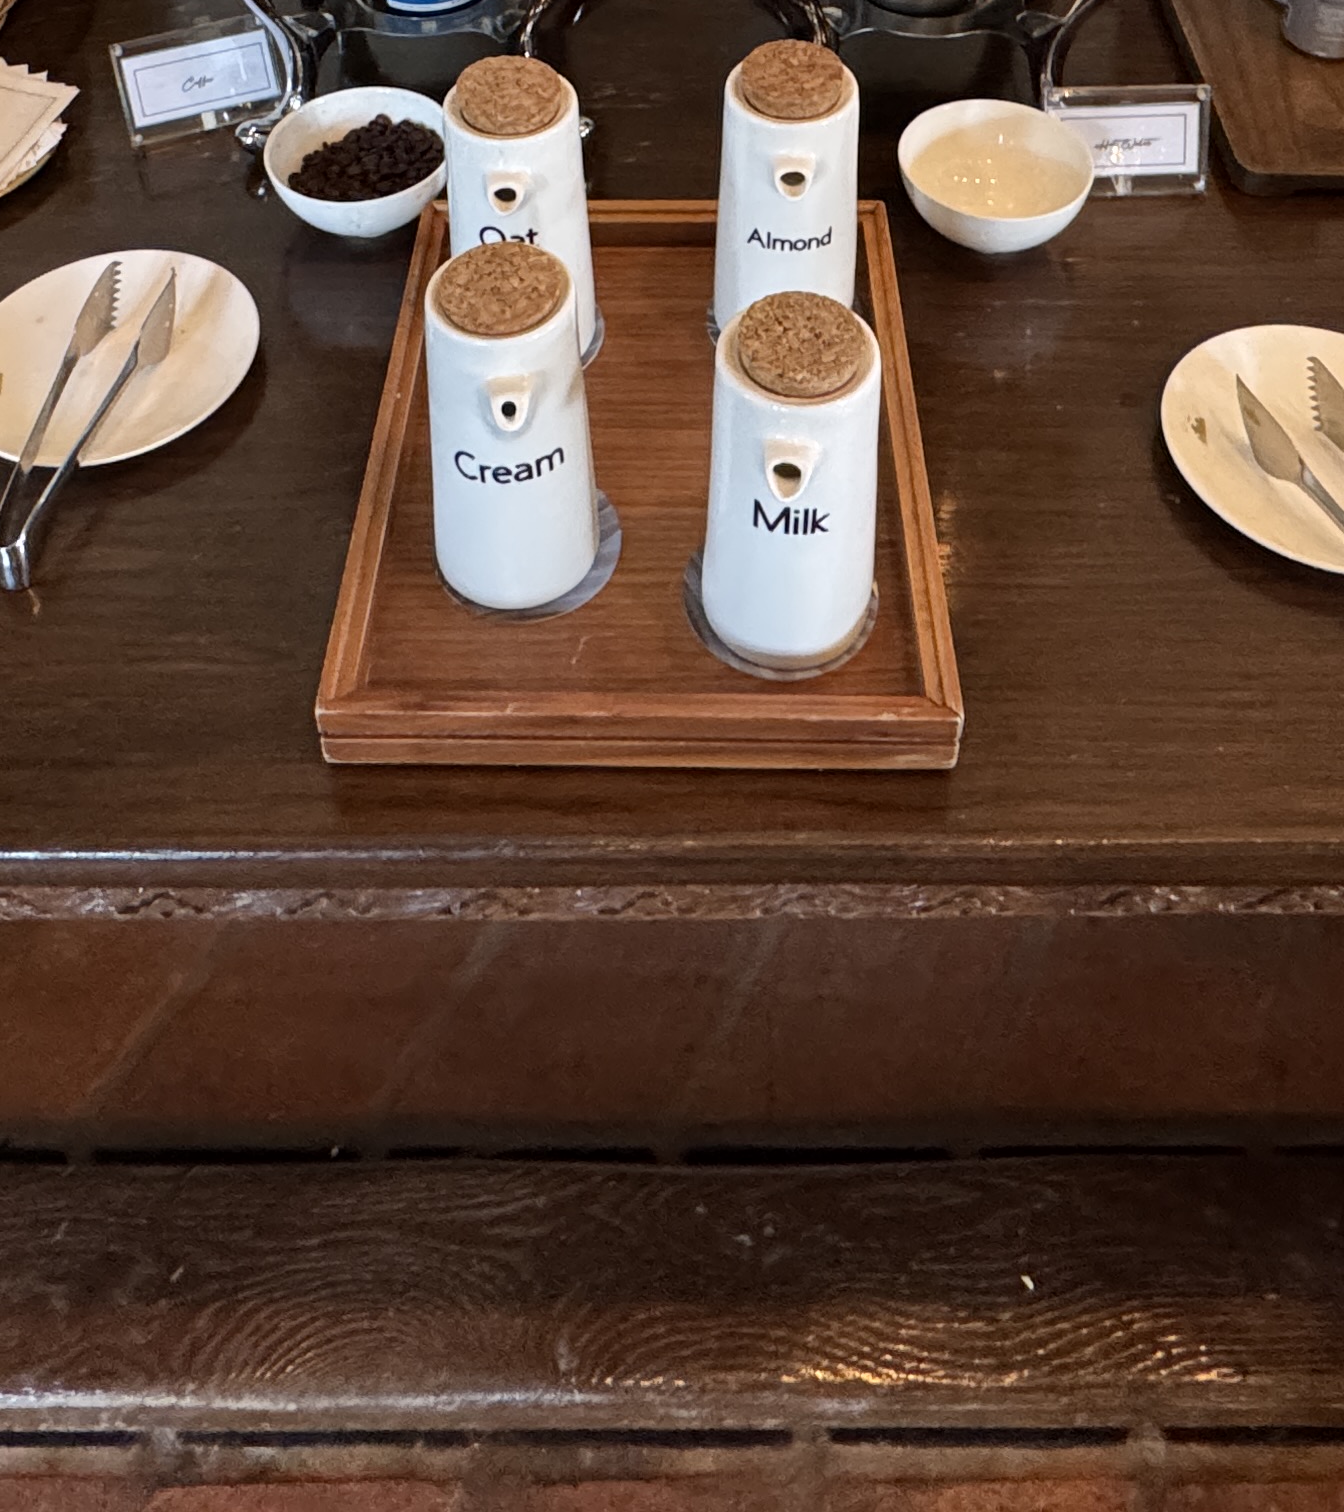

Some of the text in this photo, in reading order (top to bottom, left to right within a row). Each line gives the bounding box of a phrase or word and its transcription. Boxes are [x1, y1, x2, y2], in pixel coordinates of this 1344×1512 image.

[479, 226, 538, 245] Ot
[747, 226, 832, 251] Almond
[455, 447, 564, 484] Cream
[753, 498, 830, 535] Milk
